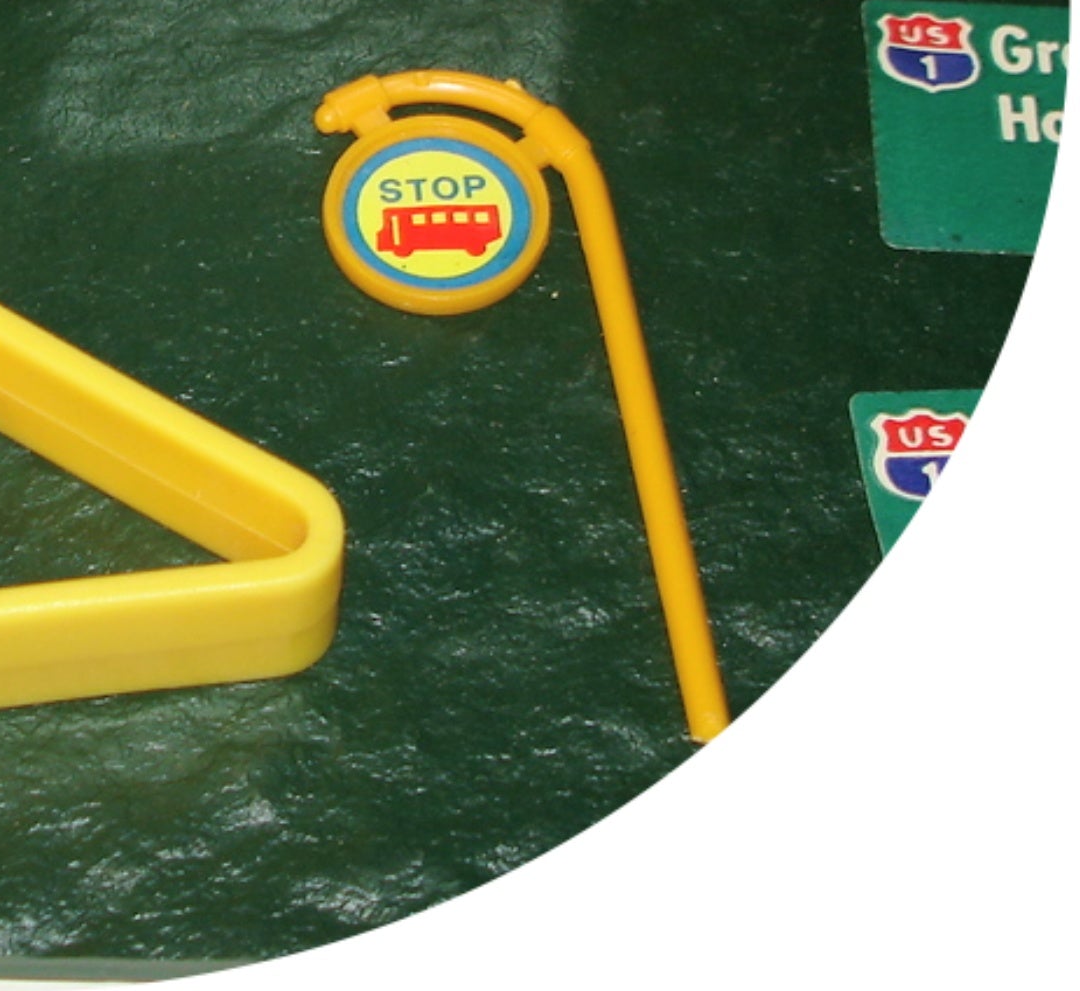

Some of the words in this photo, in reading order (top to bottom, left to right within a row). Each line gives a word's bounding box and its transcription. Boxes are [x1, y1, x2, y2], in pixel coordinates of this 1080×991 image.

[897, 24, 950, 46] US
[991, 25, 1069, 74] Gr
[919, 54, 938, 81] 1
[379, 175, 486, 202] STOP
[897, 425, 954, 448] US
